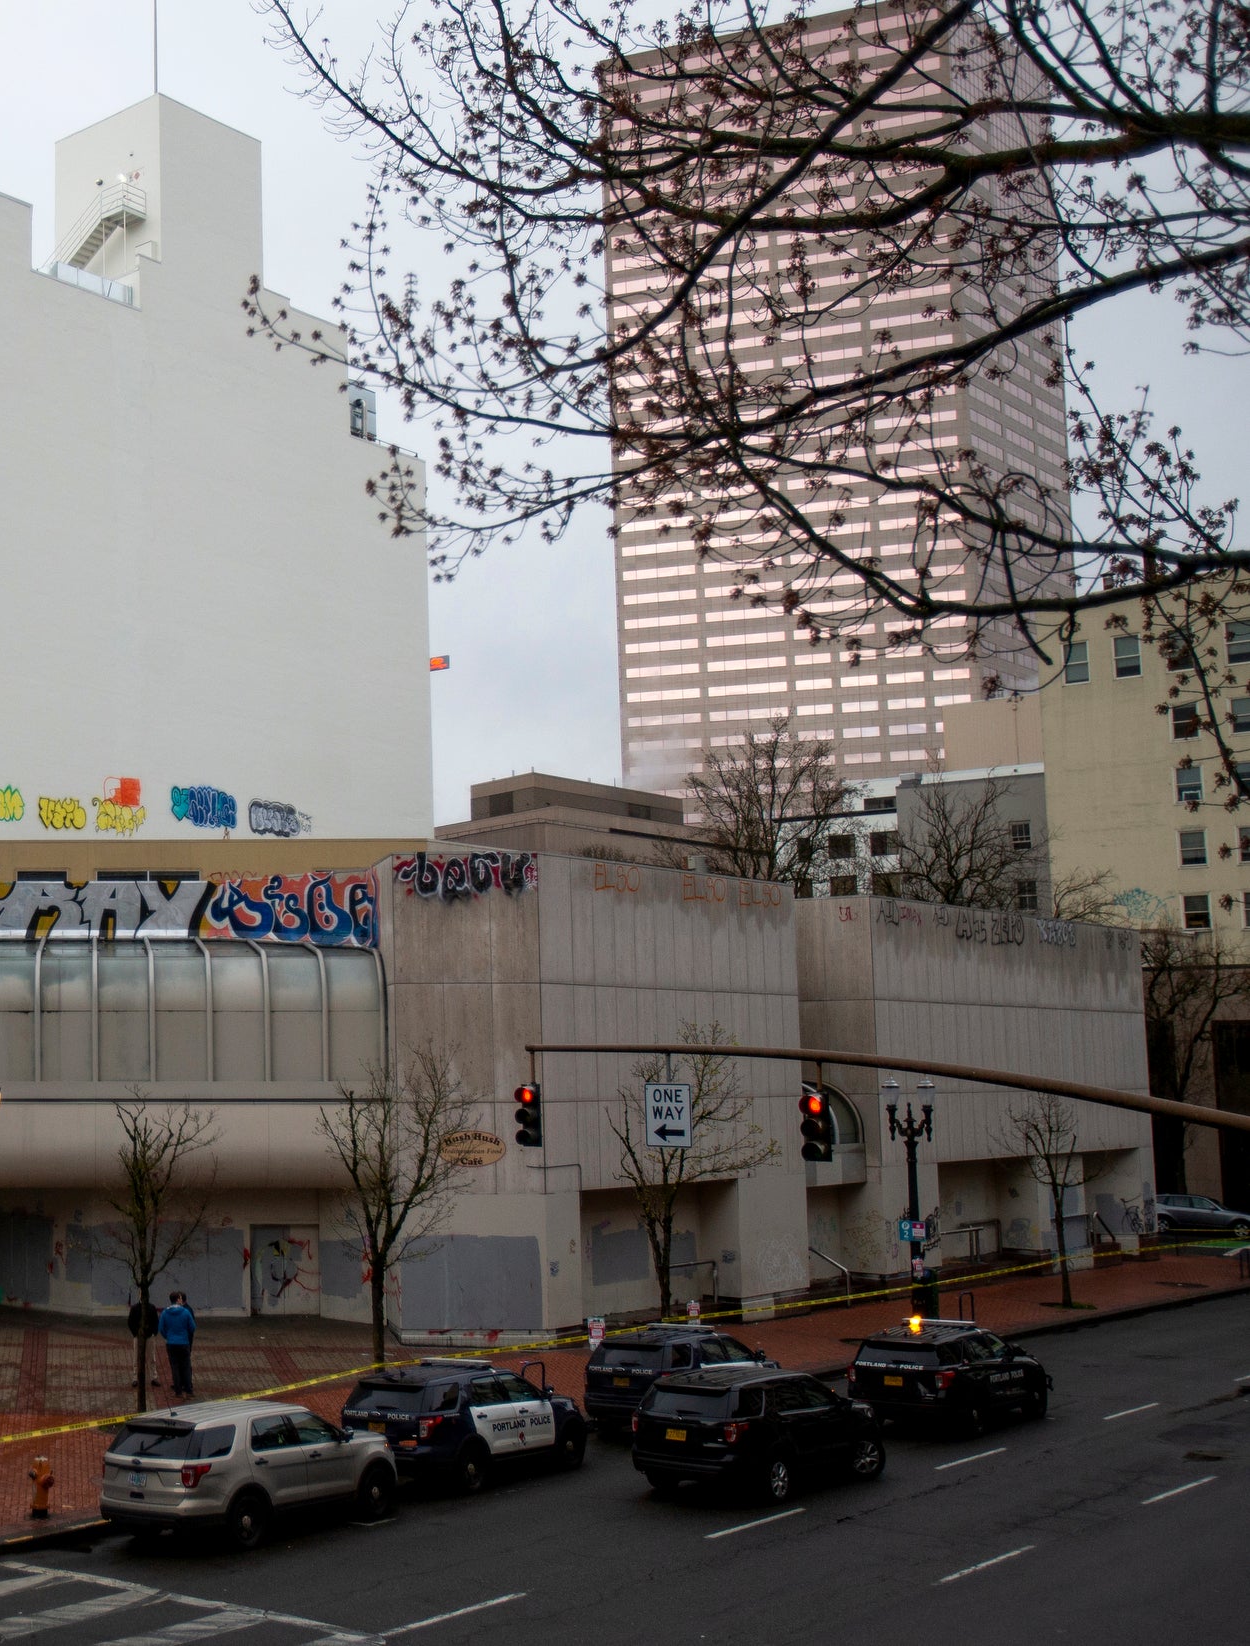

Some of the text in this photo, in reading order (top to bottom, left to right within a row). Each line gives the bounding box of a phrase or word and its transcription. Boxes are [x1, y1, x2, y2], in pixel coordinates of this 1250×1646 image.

[594, 863, 641, 893] ELSO
[683, 874, 727, 903] ELSO
[739, 880, 782, 907] ELSO
[653, 1089, 683, 1103] ONE
[653, 1106, 684, 1120] WAY
[444, 1133, 500, 1146] Hush Hush
[460, 1157, 483, 1166] Café
[589, 1365, 613, 1373] PORTLAND
[855, 1360, 887, 1368] PORTLAND
[343, 1409, 410, 1421] PORTLAND POLICE
[492, 1415, 551, 1432] PORTLAND POLICE
